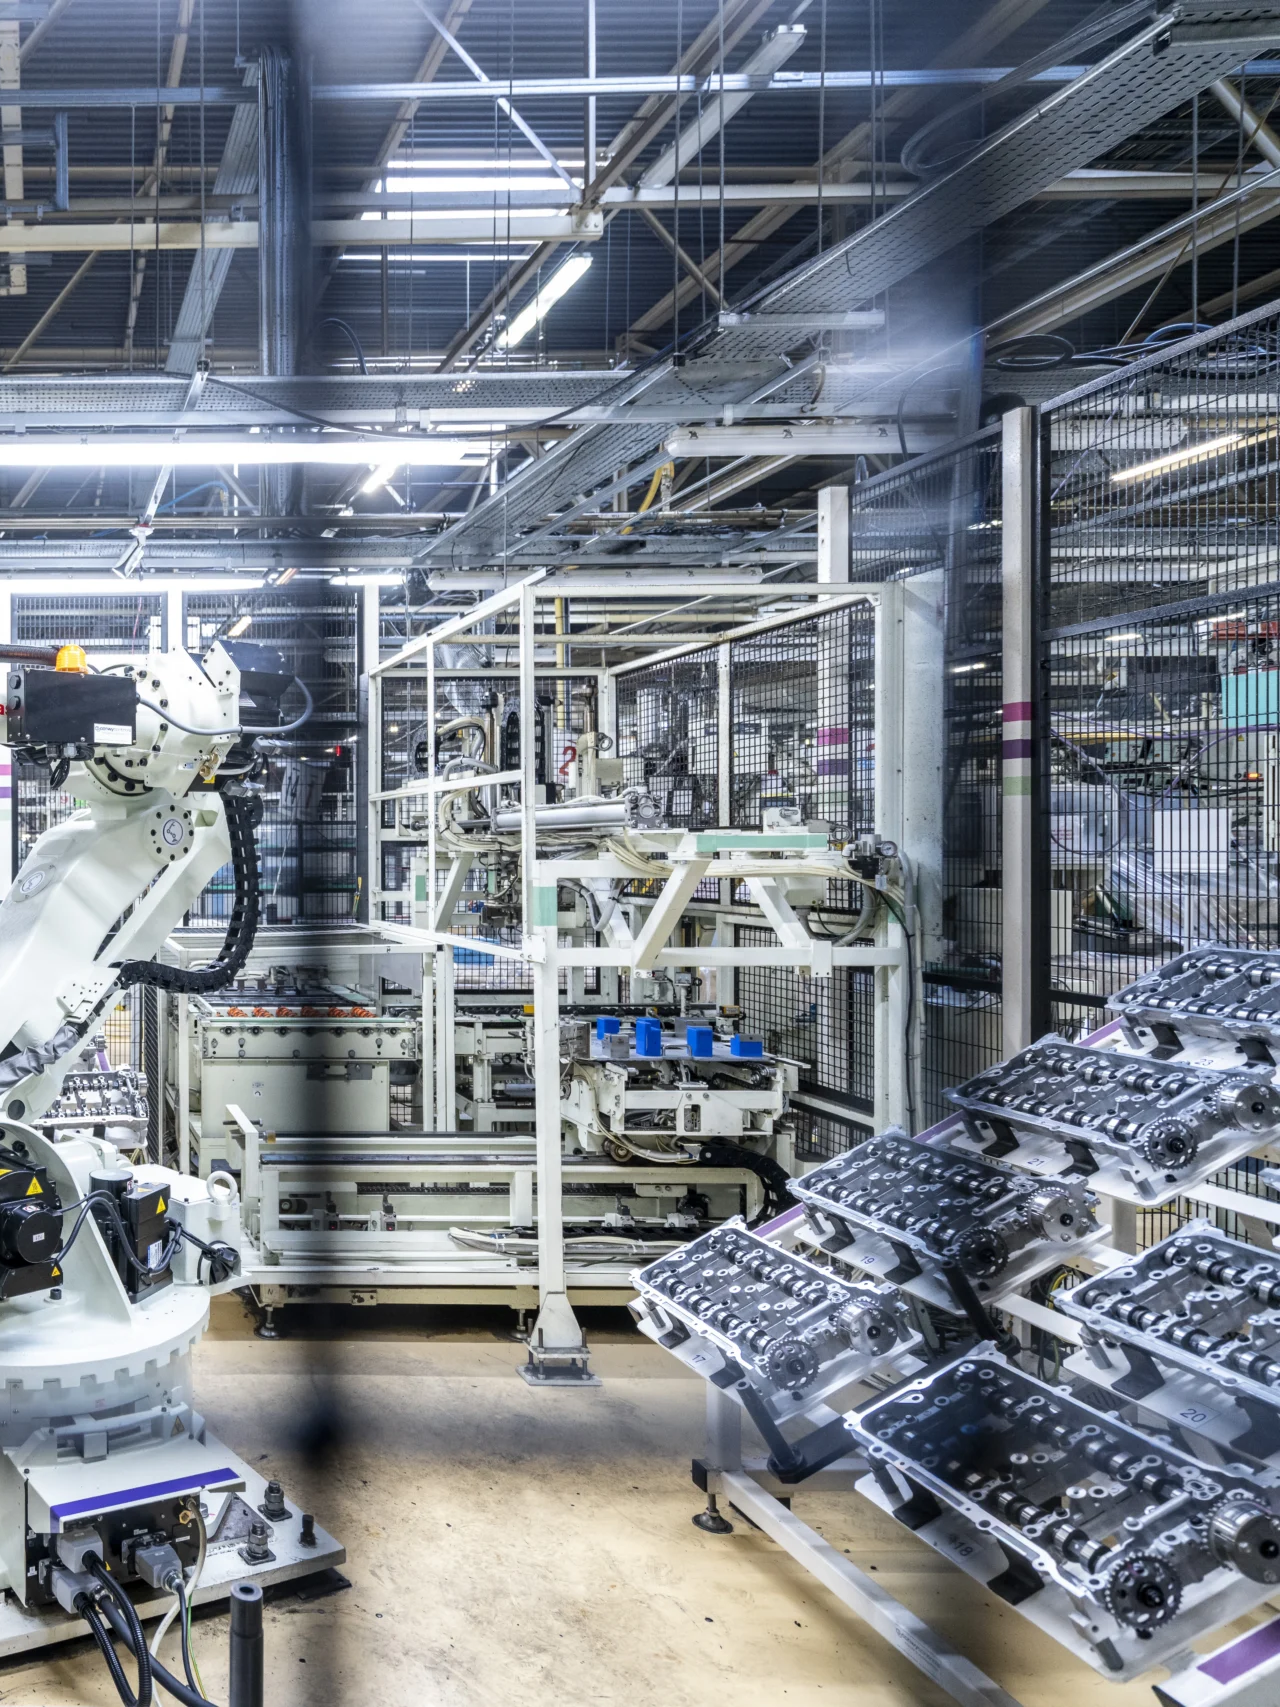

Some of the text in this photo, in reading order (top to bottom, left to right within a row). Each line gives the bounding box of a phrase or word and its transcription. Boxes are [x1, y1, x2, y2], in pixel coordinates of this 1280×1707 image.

[1194, 1058, 1214, 1066] 23
[1027, 1157, 1045, 1167] 21
[859, 1255, 875, 1265] 19
[691, 1354, 706, 1363] 17
[1180, 1408, 1207, 1423] 20
